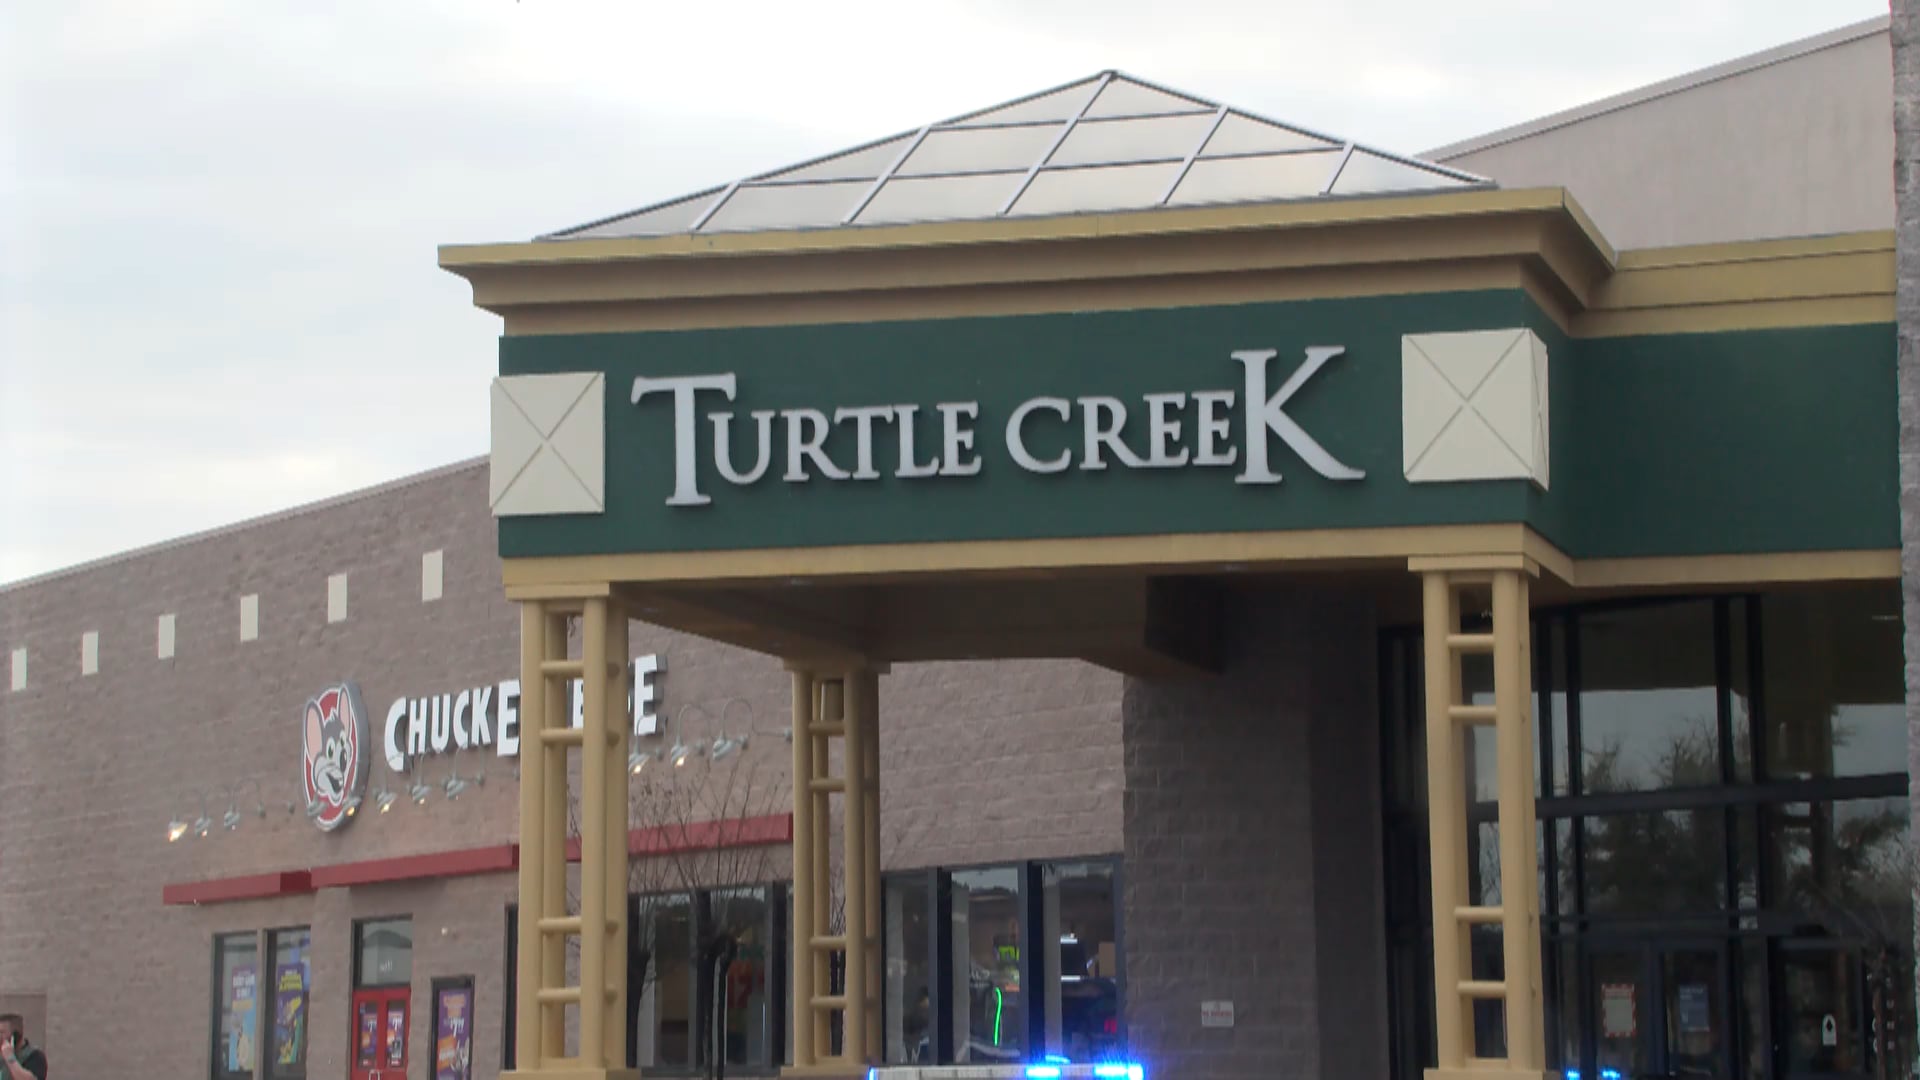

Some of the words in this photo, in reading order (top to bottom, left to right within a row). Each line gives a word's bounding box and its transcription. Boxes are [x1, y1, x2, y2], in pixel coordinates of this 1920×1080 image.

[631, 372, 982, 506] TURTLE
[1005, 345, 1367, 485] CREEK
[384, 685, 492, 772] CHUCK
